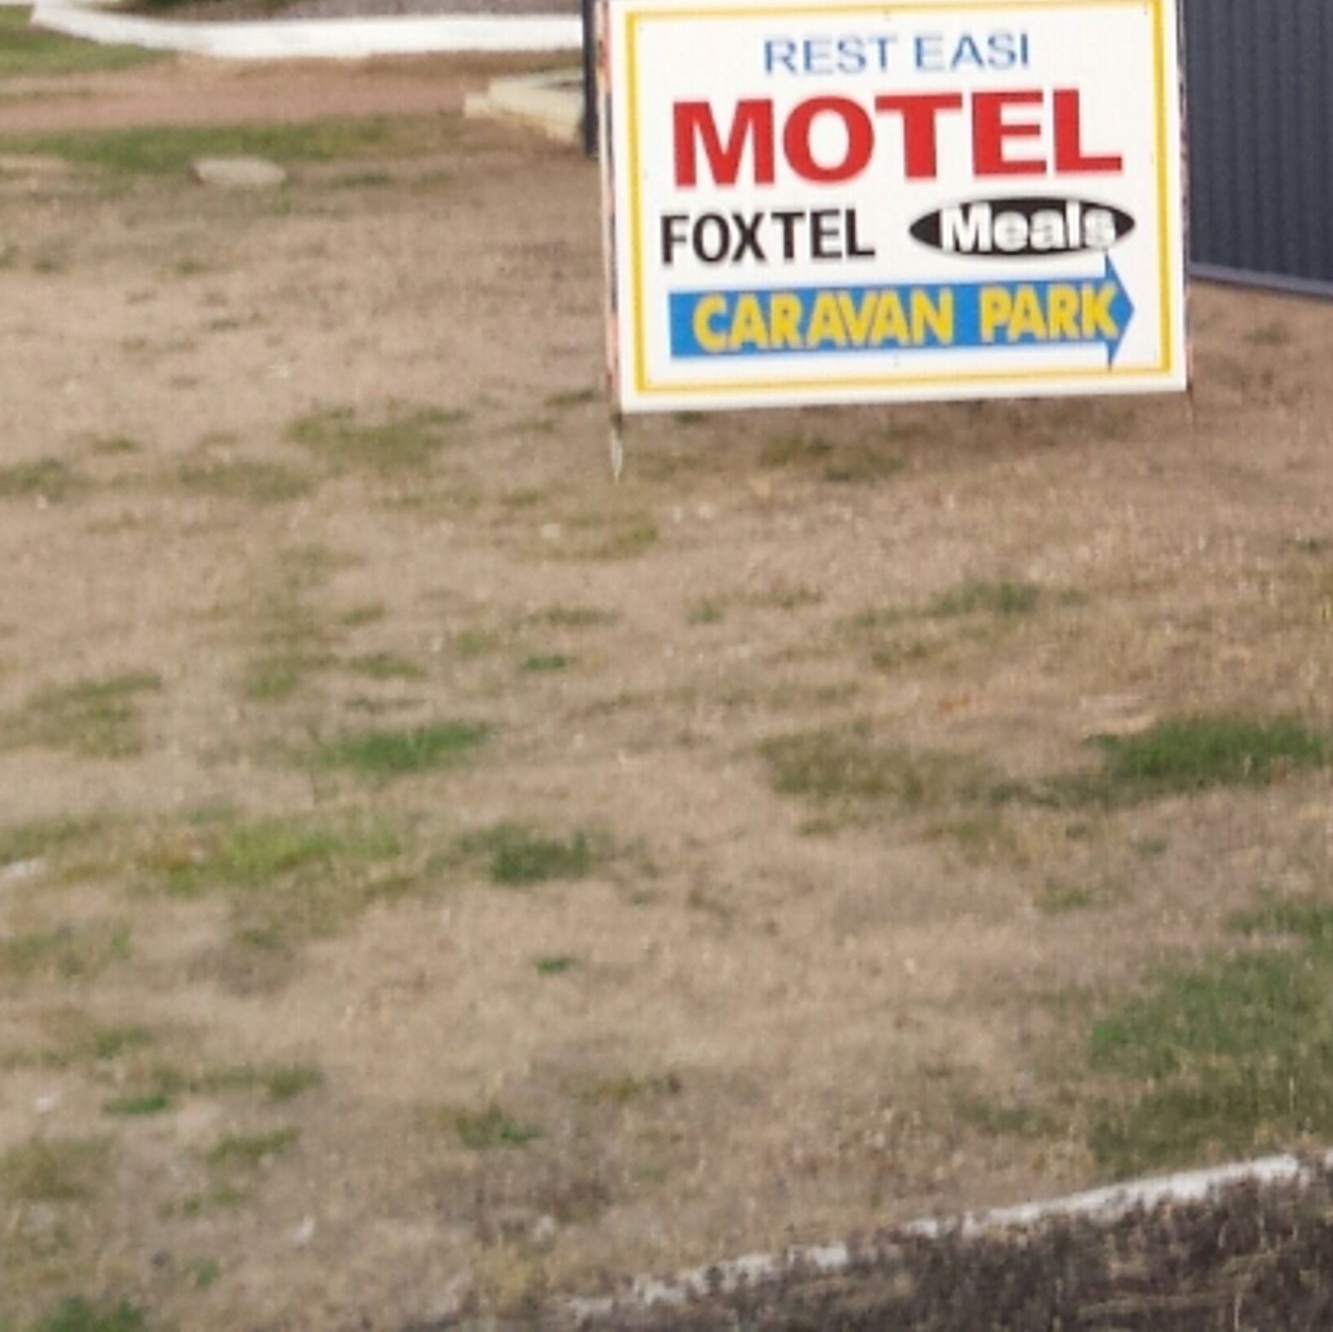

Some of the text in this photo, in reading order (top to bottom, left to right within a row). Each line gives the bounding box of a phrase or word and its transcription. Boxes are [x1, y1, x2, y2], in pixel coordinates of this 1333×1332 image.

[765, 33, 1029, 76] REST EASI
[672, 89, 1124, 189] MOTEL
[660, 202, 1118, 265] FOXTEL Meals
[692, 283, 1119, 354] CARAVAN PARK
